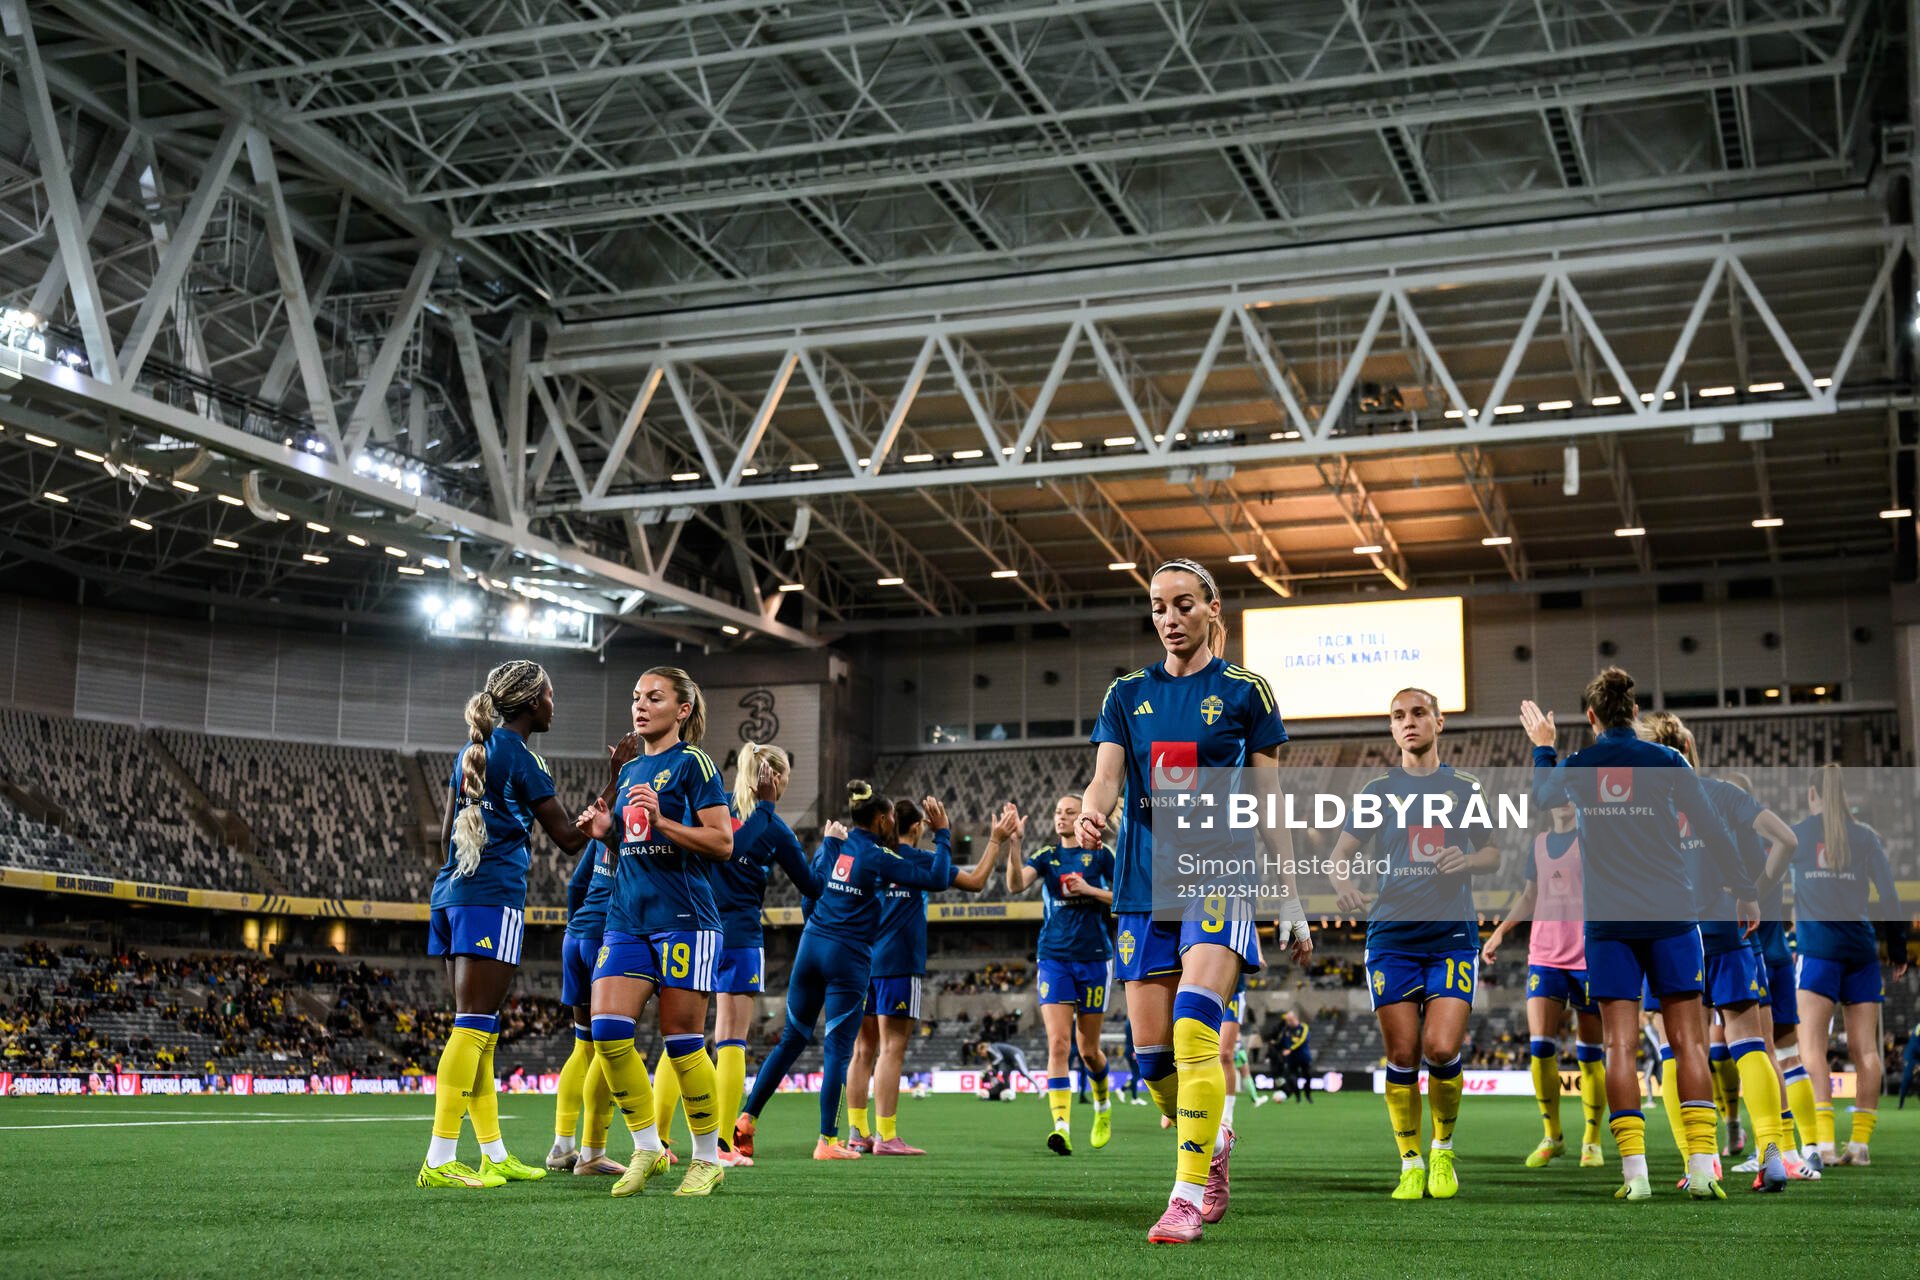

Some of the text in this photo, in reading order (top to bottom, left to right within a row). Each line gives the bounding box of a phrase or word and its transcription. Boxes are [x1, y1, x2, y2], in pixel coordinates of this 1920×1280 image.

[1318, 634, 1353, 648] TACK
[1284, 652, 1346, 668] DAGENS
[1583, 806, 1655, 816] SVENSKA SPEL
[649, 845, 674, 855] SPEL
[1393, 865, 1438, 877] SVENSKA
[844, 885, 863, 897] SPEL
[1201, 893, 1227, 934] 9
[661, 941, 691, 979] 19
[1445, 957, 1472, 994] 15
[1085, 986, 1104, 1009] 18
[14, 1077, 82, 1094] SVENSKA SPEL
[141, 1077, 201, 1094] SVENSKA SPEL
[252, 1078, 287, 1094] SVENSKA
[351, 1079, 381, 1094] SVENSKA
